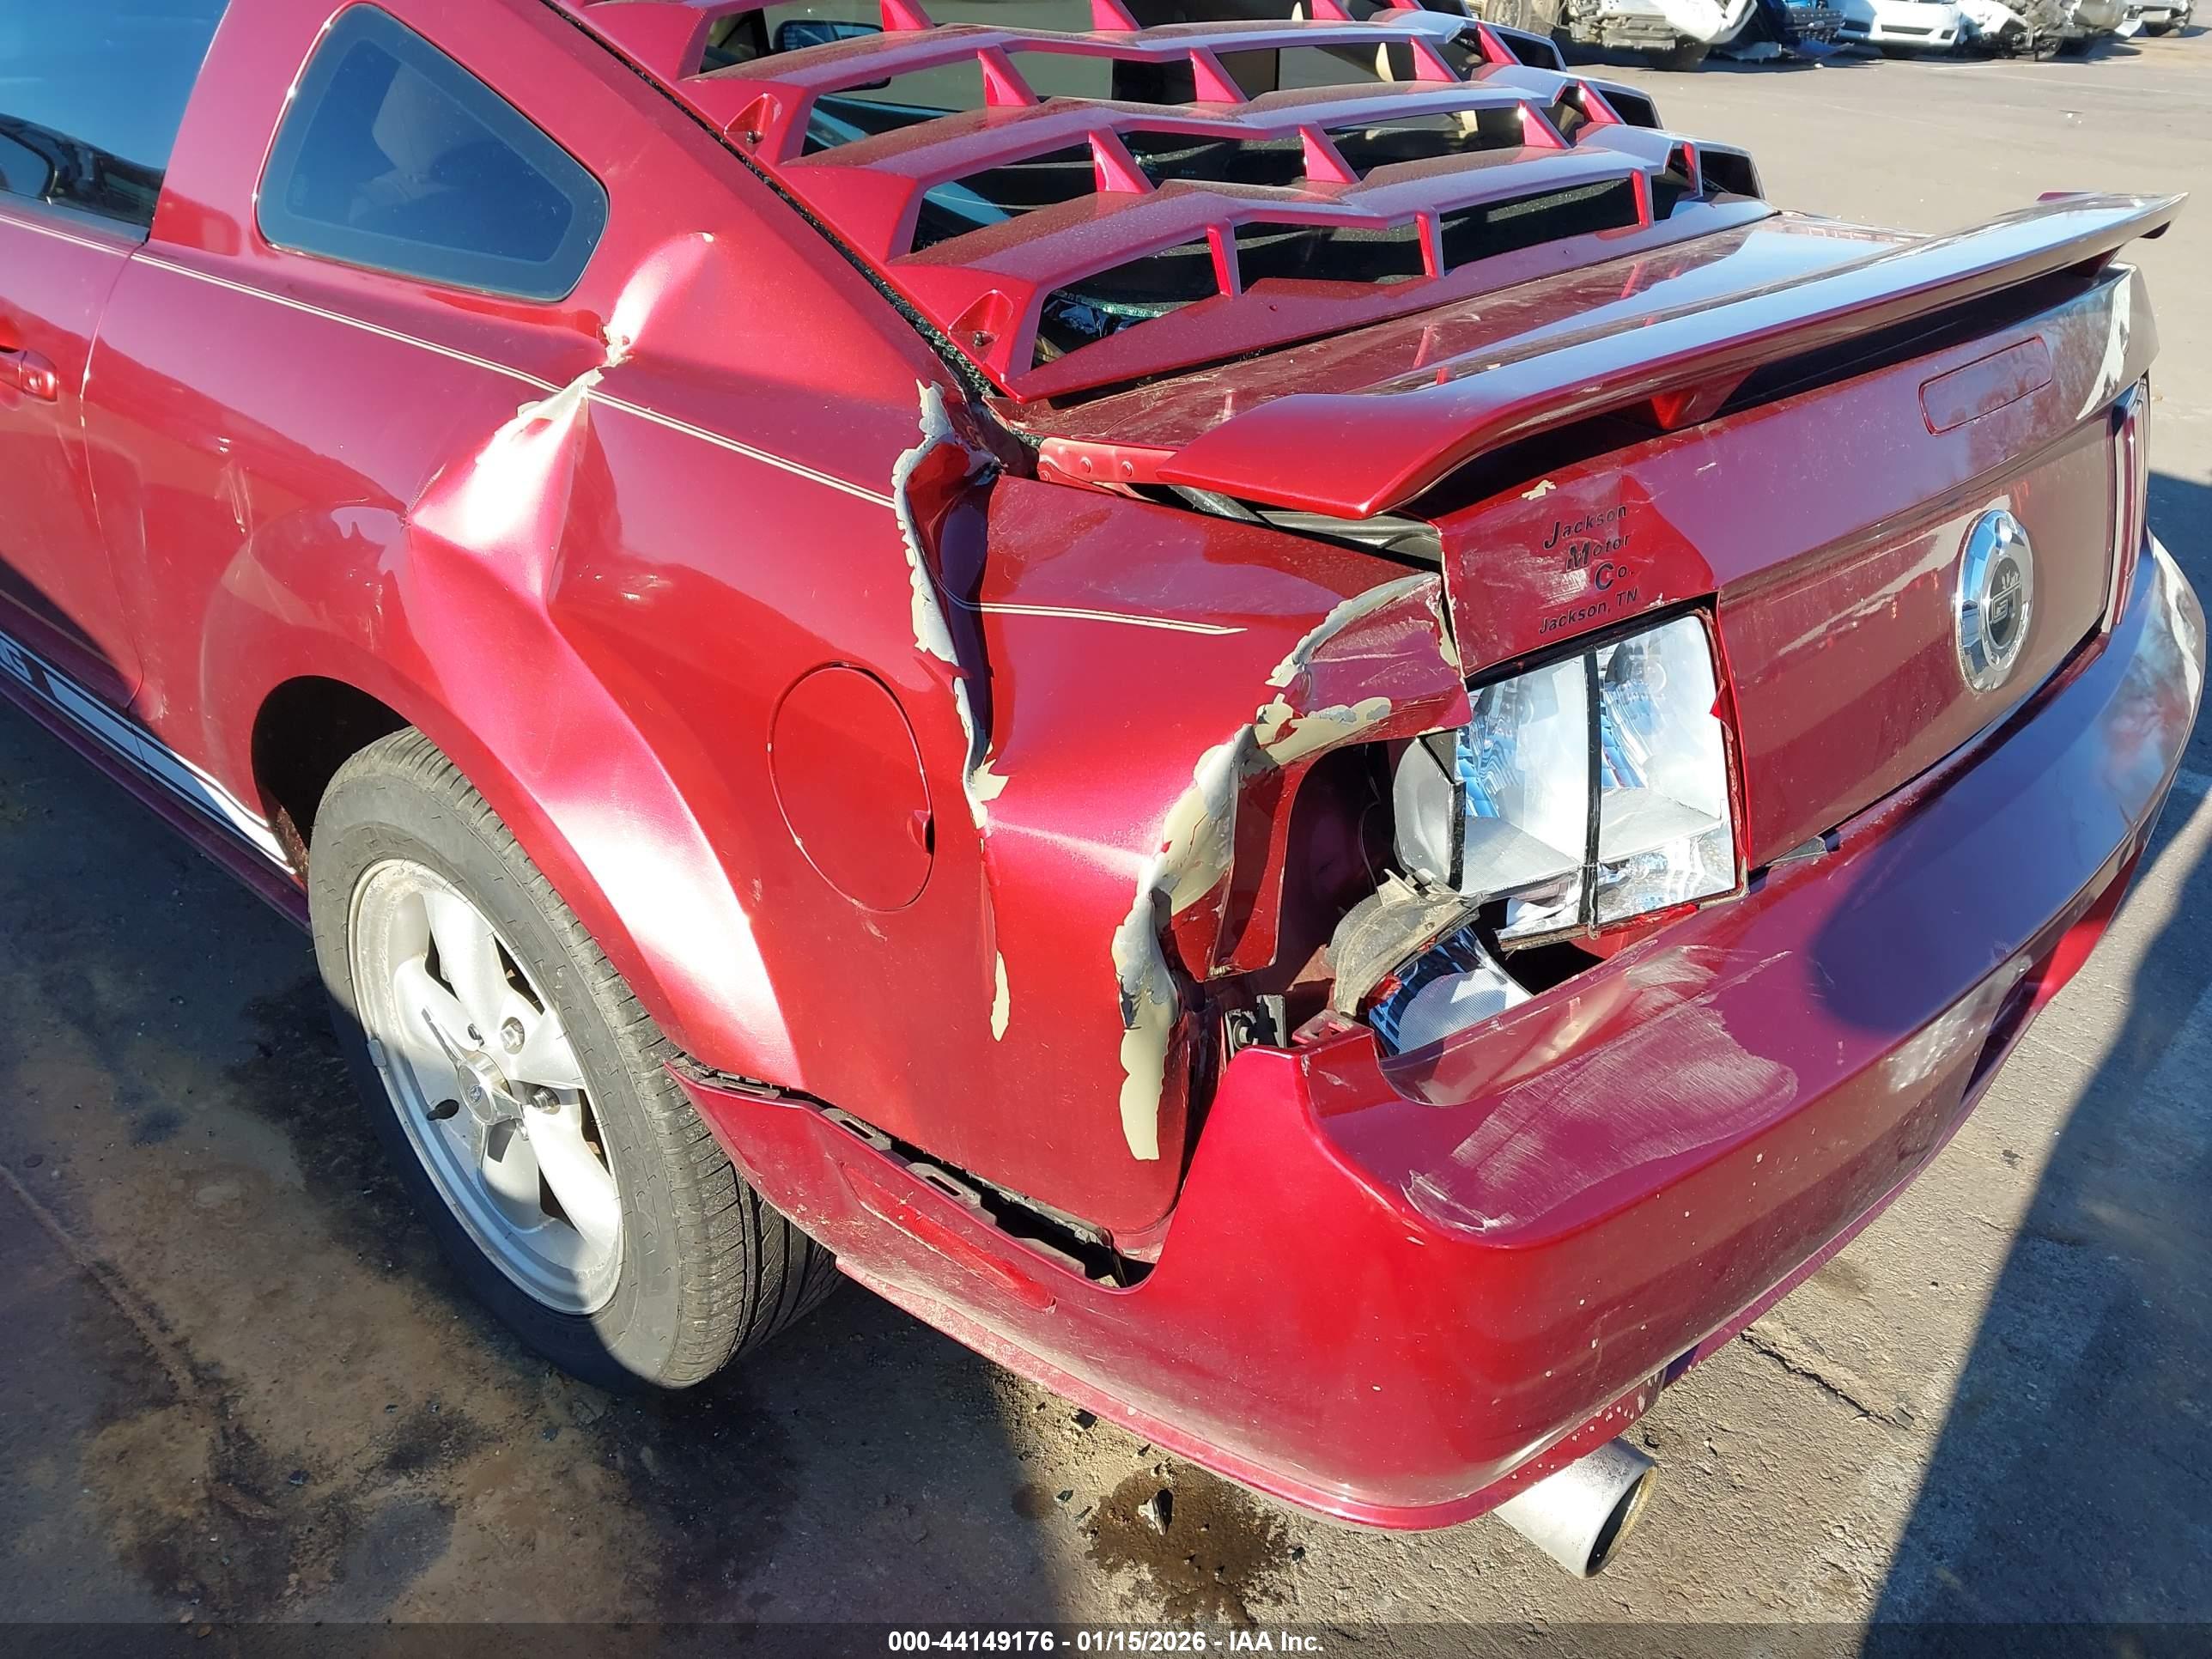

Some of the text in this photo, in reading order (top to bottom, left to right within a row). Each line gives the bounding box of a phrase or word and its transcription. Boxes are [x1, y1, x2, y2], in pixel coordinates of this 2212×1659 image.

[1544, 506, 1626, 549] Jackson
[1565, 534, 1632, 572] Motor
[1594, 562, 1635, 592] Co.
[1539, 589, 1638, 635] Jackson, TN
[1991, 582, 2021, 624] GT
